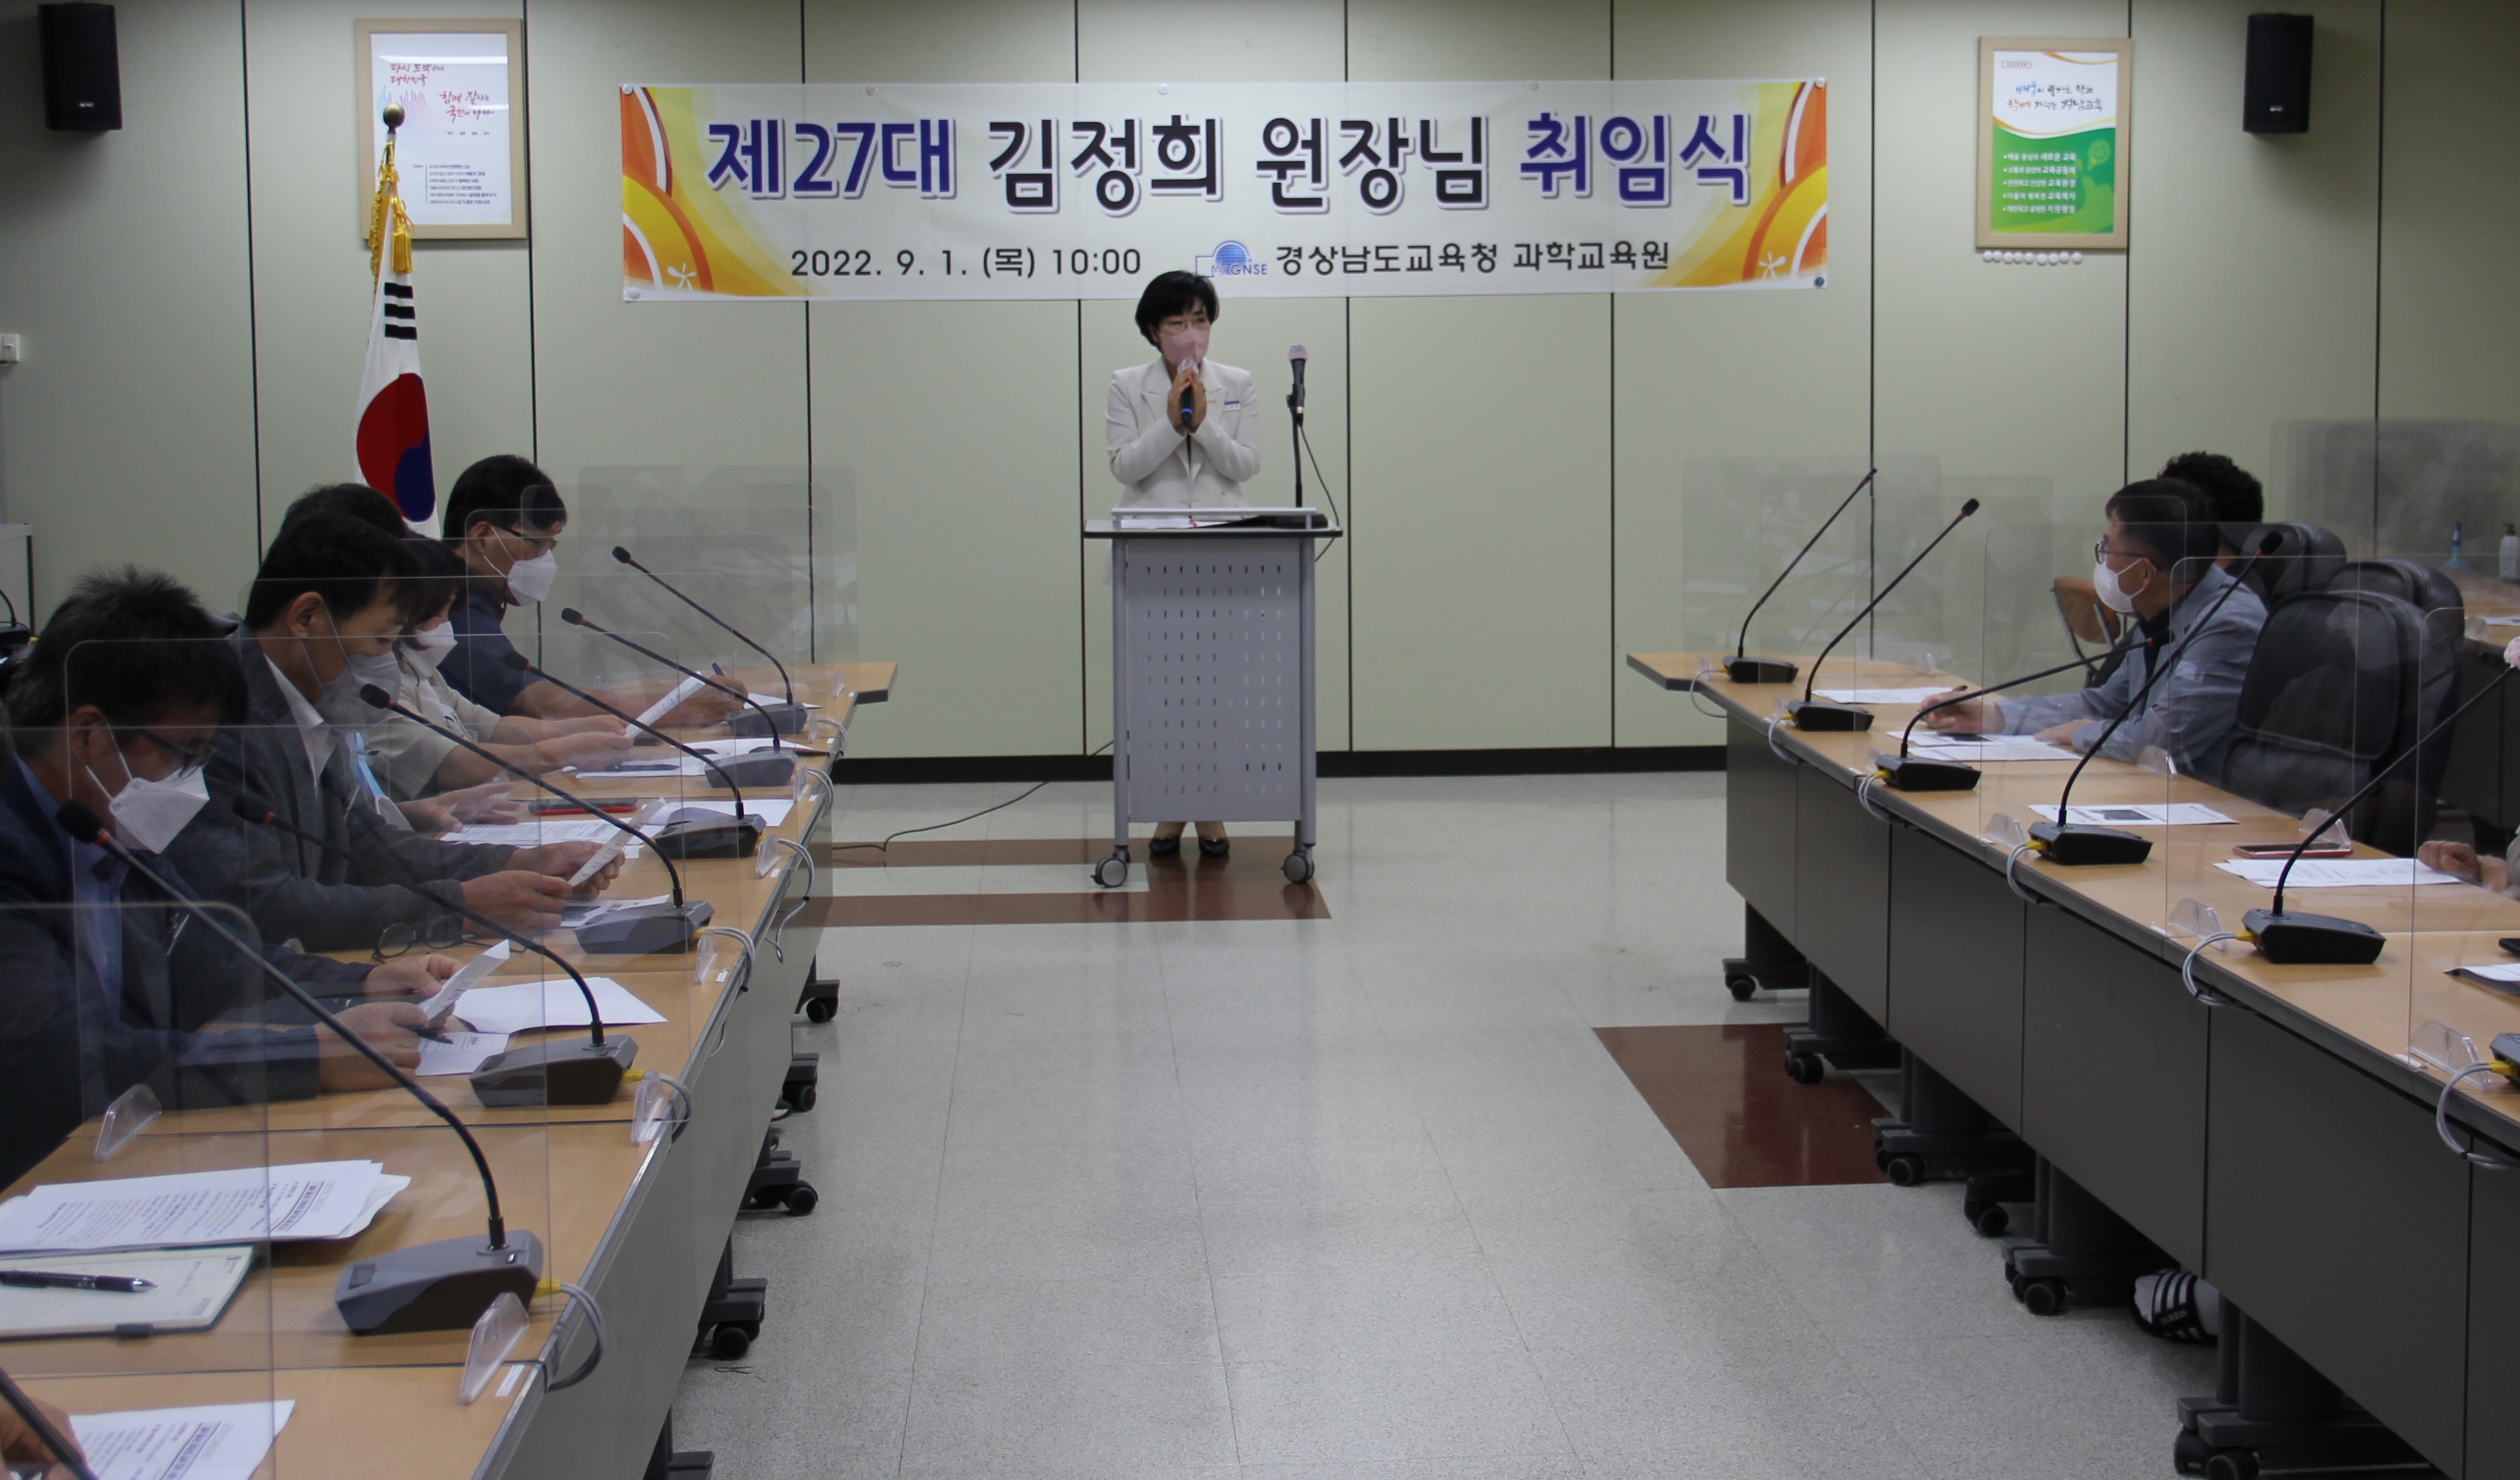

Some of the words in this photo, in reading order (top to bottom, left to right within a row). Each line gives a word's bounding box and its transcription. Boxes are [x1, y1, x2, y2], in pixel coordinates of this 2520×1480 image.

[390, 63, 410, 73] 다시
[390, 73, 428, 87] 대한민국
[439, 90, 462, 104] 함께
[465, 90, 489, 105] 잘사는
[707, 118, 954, 197] 제27대
[989, 115, 1218, 210] 김정희
[1256, 117, 1487, 208] 원장님
[1519, 111, 1750, 202] 취임식
[791, 249, 881, 277] 2022.
[896, 249, 924, 276] 9.
[942, 249, 967, 276] 1.
[983, 247, 1035, 279] (목)
[1052, 248, 1141, 275] 10:00
[1276, 242, 1498, 276] 경상남도교육청
[1512, 240, 1670, 272] 과학교육원
[1230, 264, 1268, 276] GNSE
